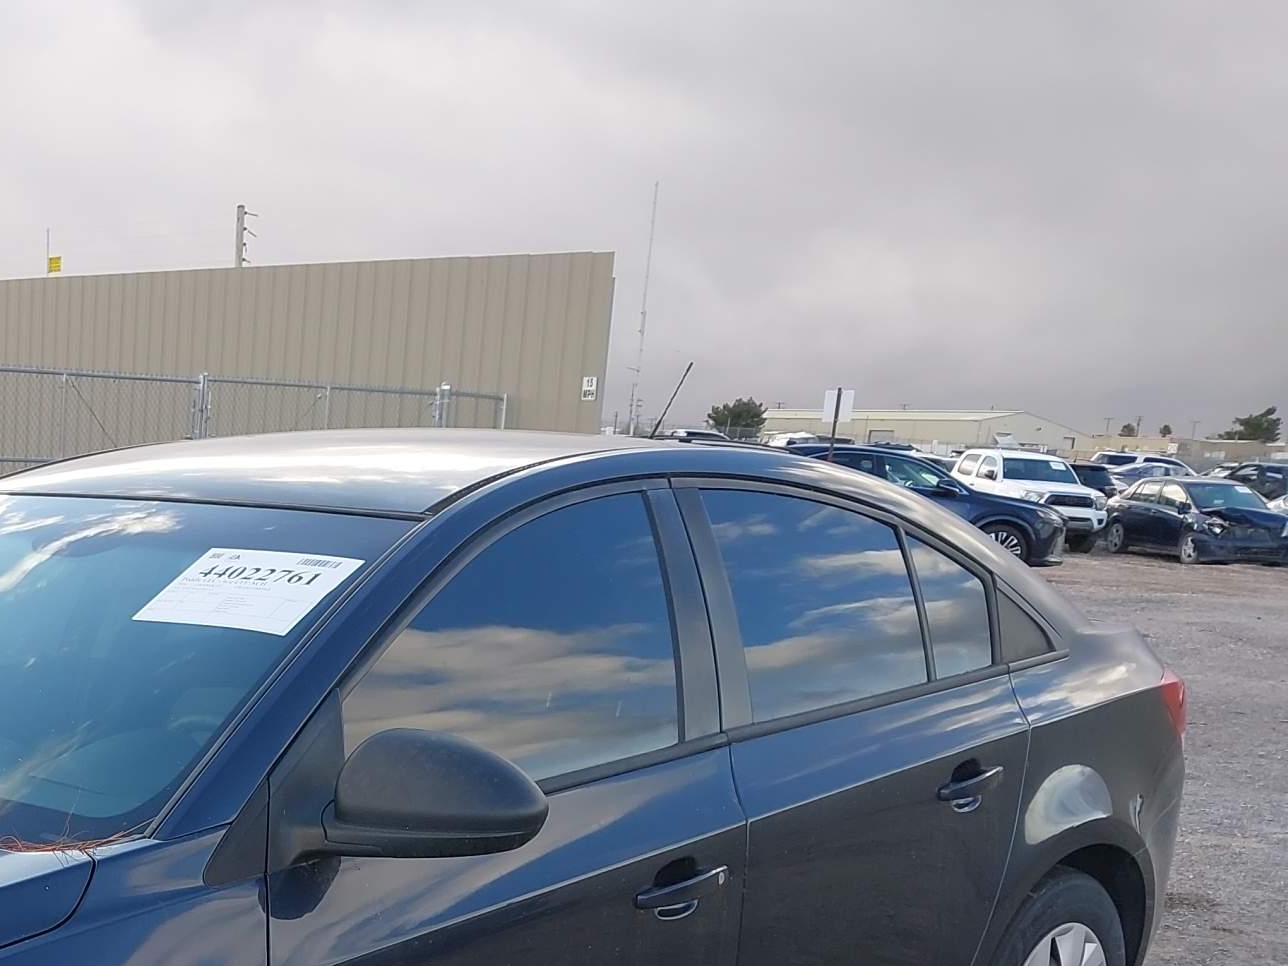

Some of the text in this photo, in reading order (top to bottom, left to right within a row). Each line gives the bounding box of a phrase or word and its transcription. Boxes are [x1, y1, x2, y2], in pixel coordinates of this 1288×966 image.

[587, 377, 594, 388] 15
[583, 389, 595, 398] MPH
[199, 563, 323, 587] 44022761
